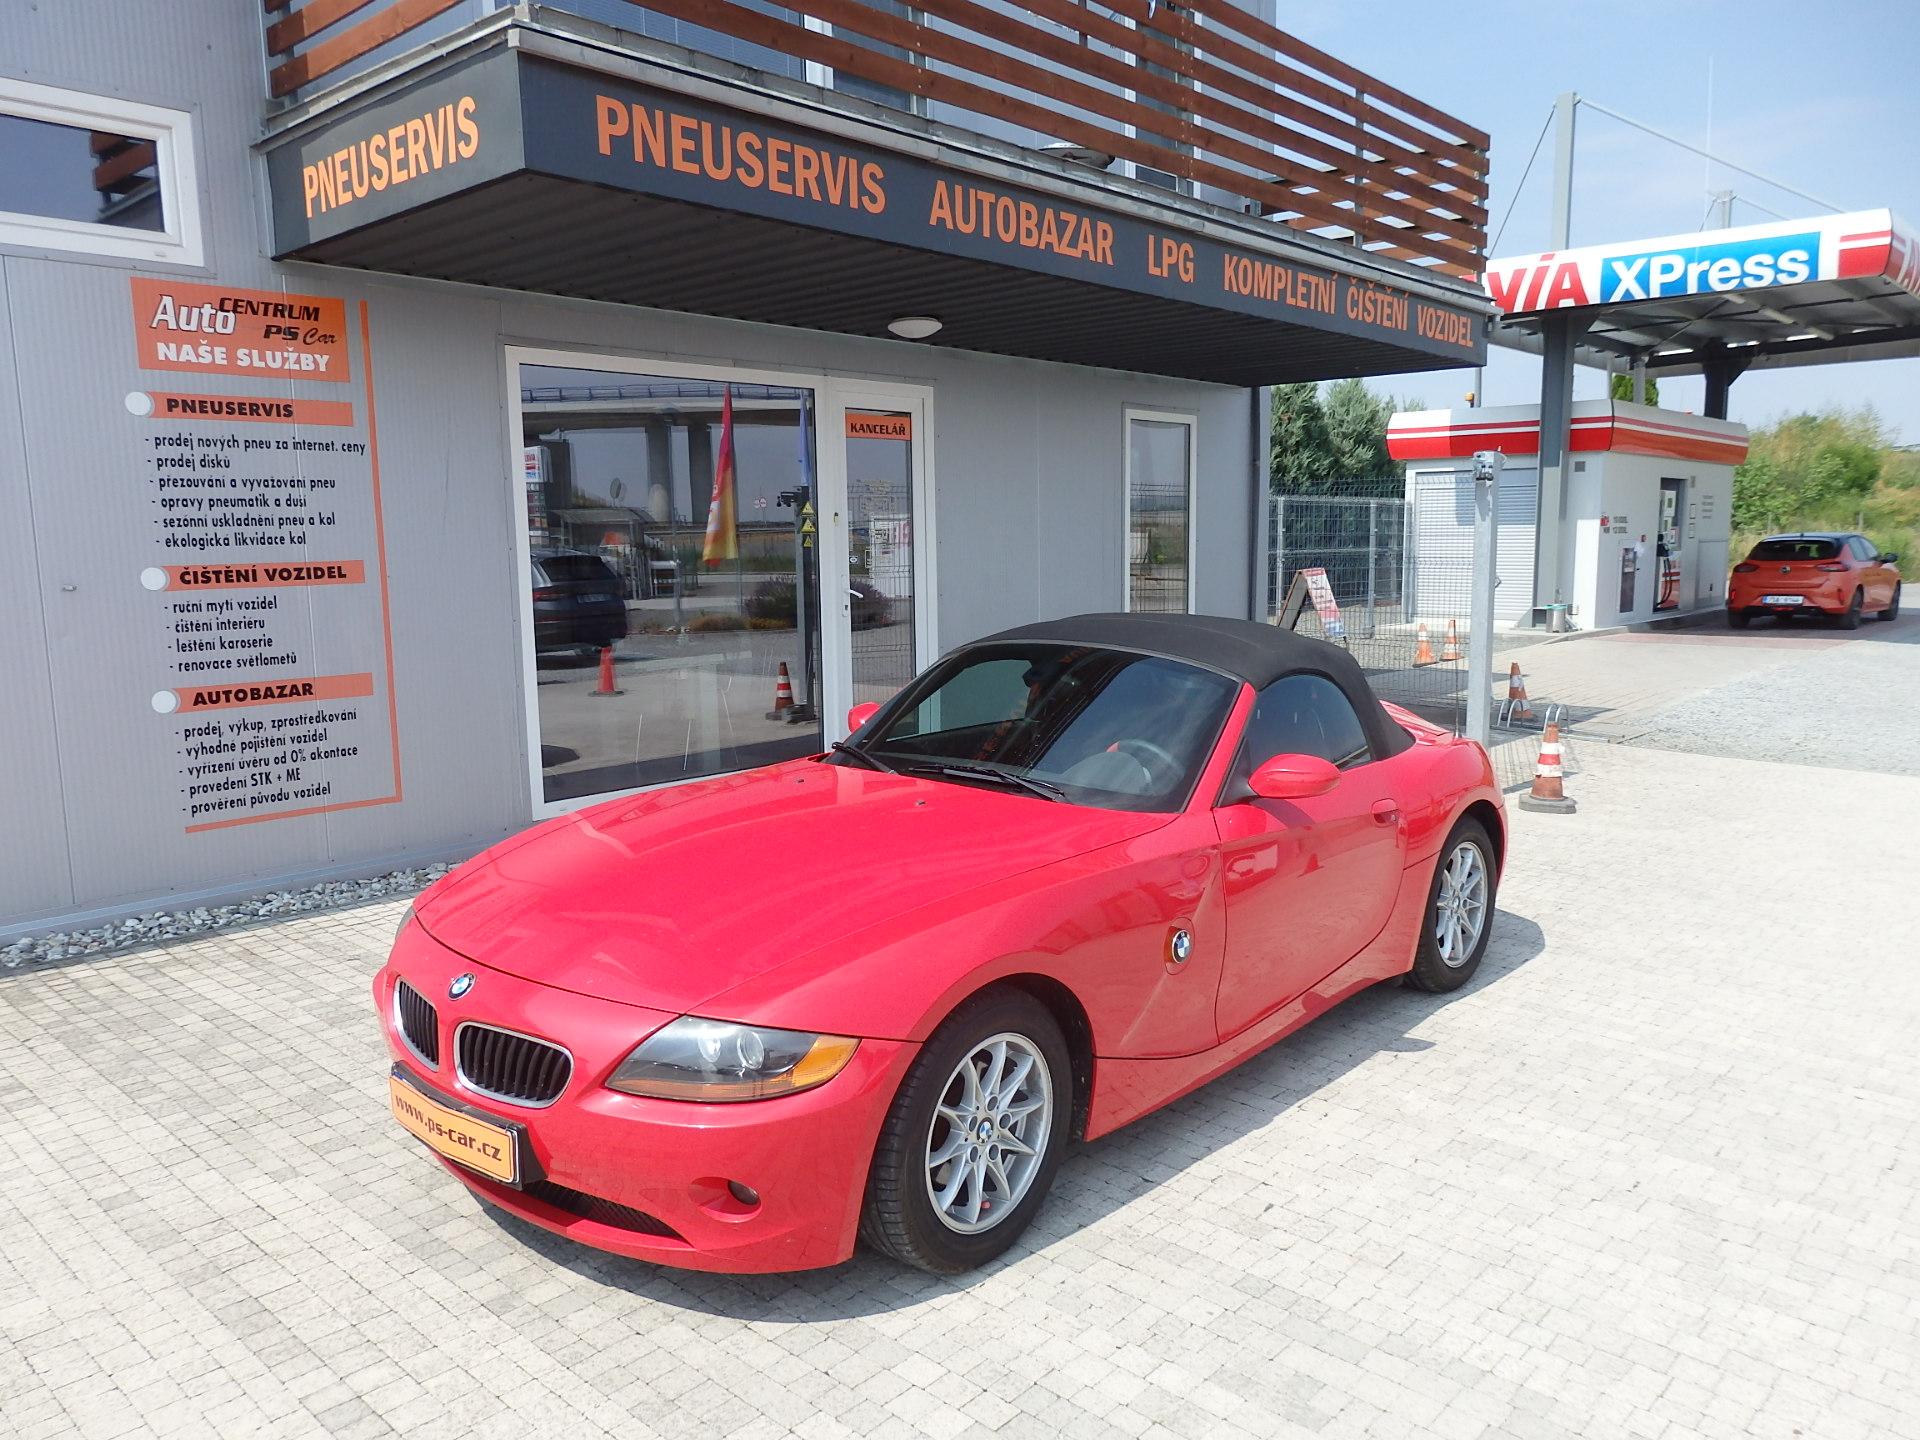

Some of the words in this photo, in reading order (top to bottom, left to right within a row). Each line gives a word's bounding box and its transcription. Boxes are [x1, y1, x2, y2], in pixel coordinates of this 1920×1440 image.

[302, 95, 480, 219] PNEUSERVIS
[596, 94, 887, 214] PNEUSERVIS
[929, 180, 1115, 267] AUTOBAZAR
[1147, 234, 1195, 284] LPG
[1224, 252, 1339, 316] KOMPLETNÍ
[1346, 276, 1410, 332] ČIŠTĚNÍ
[1416, 305, 1474, 348] VOZIDEL
[1608, 247, 1811, 303] XPress
[150, 294, 236, 335] Auto
[218, 297, 320, 322] CENTRUM
[263, 325, 300, 341] PS
[302, 328, 337, 345] Car
[156, 339, 227, 366] NAŠE
[236, 346, 330, 372] SLUŽBY
[166, 398, 294, 418] PNEUSERVIS
[154, 432, 194, 451] prodej
[197, 434, 240, 451] nových
[244, 439, 271, 452] pneu
[275, 441, 289, 450] za
[292, 436, 338, 452] internet.
[341, 443, 366, 456] ceny
[156, 453, 196, 472] prodej
[159, 475, 226, 491] přezouvání
[230, 478, 237, 488] a
[241, 475, 306, 492] vyvažování
[309, 479, 336, 492] pneu
[161, 498, 203, 511] opravy
[208, 494, 270, 511] pneumatik
[274, 498, 281, 507] a
[211, 512, 275, 528] uskladnění
[278, 516, 305, 529] pneu
[308, 516, 316, 525] a
[319, 511, 336, 525] kol
[165, 532, 230, 551] ekologická
[234, 531, 286, 546] likvidace
[289, 530, 307, 545] kol
[179, 564, 258, 585] ČIŠTĚNÍ
[263, 565, 347, 582] VOZIDEL
[173, 599, 203, 613] ruční
[237, 595, 278, 611] vozidel
[175, 618, 213, 633] čištění
[216, 615, 266, 631] interiéru
[176, 637, 216, 653] leštění
[219, 633, 273, 650] karoserie
[178, 659, 233, 673] renovace
[236, 652, 297, 668] světlometů
[193, 682, 314, 707] AUTOBAZAR
[270, 708, 357, 731] zprostředkování
[185, 739, 237, 760] výhodné
[240, 735, 286, 754] pojištění
[289, 727, 328, 745] vozidel
[187, 758, 235, 779] vyřízení
[238, 757, 270, 770] úvěru
[273, 751, 287, 765] od
[290, 748, 307, 763] 0%
[310, 746, 358, 761] akontace
[189, 776, 247, 799] provedení
[250, 771, 272, 787] STK
[286, 767, 301, 782] ME
[250, 787, 290, 808] původu
[293, 781, 331, 799] vozidel
[395, 1095, 503, 1162] www.ps-car.cz
